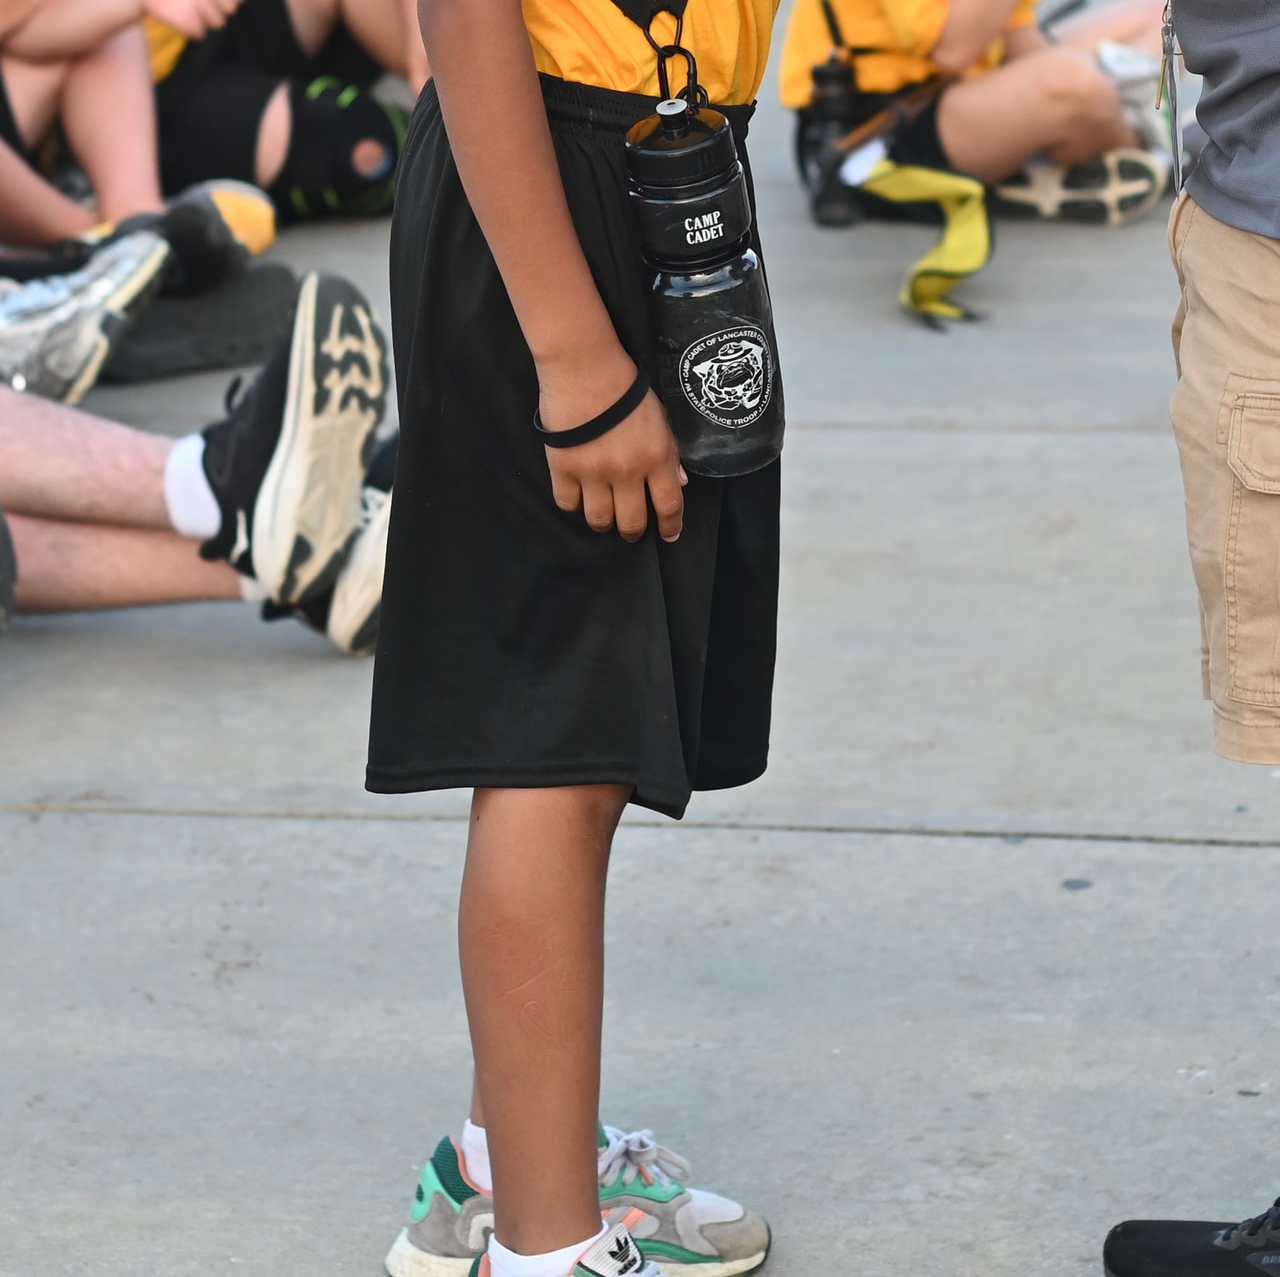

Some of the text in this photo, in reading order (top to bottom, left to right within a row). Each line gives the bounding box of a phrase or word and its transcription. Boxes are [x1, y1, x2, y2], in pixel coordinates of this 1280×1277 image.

[684, 210, 721, 231] CAMP
[686, 223, 724, 245] CADET
[683, 359, 691, 378] CAMP
[687, 342, 706, 361] CADET
[706, 337, 717, 346] OF
[718, 330, 757, 341] LANCASTER
[684, 383, 692, 392] PA
[688, 392, 706, 412] STATE
[704, 409, 732, 425] POLICE
[734, 410, 758, 425] TROOP
